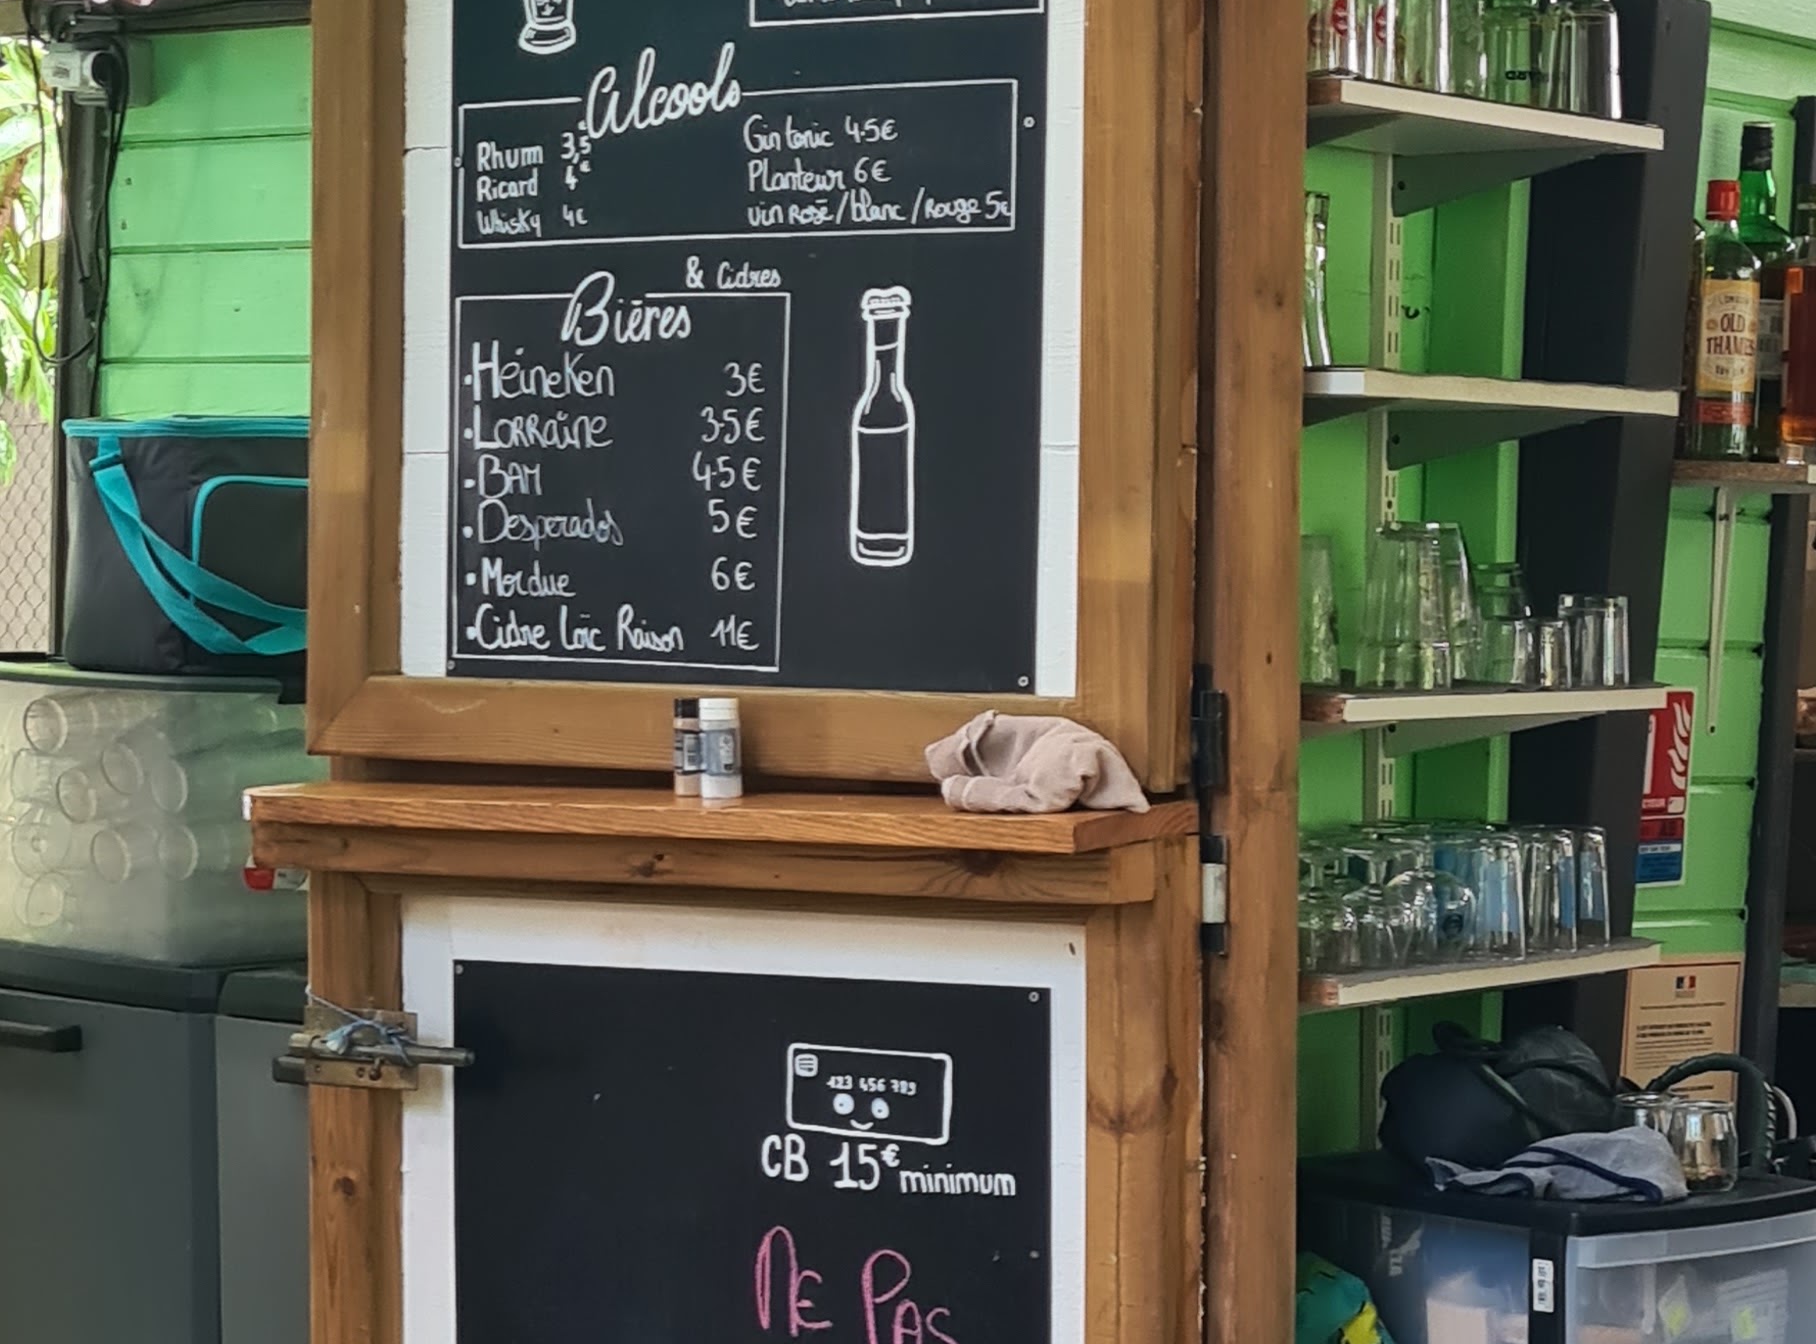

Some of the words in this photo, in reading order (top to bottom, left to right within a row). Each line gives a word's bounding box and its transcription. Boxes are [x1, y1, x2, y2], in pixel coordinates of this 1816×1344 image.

[585, 42, 742, 139] Alcools
[743, 114, 781, 154] Gin
[785, 115, 834, 150] tonic
[476, 141, 544, 172] Rhum
[748, 157, 847, 193] Planteur
[853, 156, 892, 183] 6€
[476, 167, 538, 203] Ricard
[476, 208, 542, 237] Whisky
[562, 204, 588, 228] 4€
[685, 255, 704, 289] &
[717, 261, 782, 290] Cidres
[1720, 313, 1746, 333] OLD
[723, 362, 765, 397] 3€
[478, 497, 624, 551] Desperados
[481, 557, 576, 597] Mordue
[474, 603, 551, 650] Cidre
[617, 603, 685, 652] Raison
[709, 614, 760, 651] 11€
[826, 1075, 853, 1091] 123
[859, 1077, 886, 1093] 456
[761, 1133, 809, 1182] CB
[829, 1142, 901, 1190] 15€
[899, 1164, 1017, 1196] minimum
